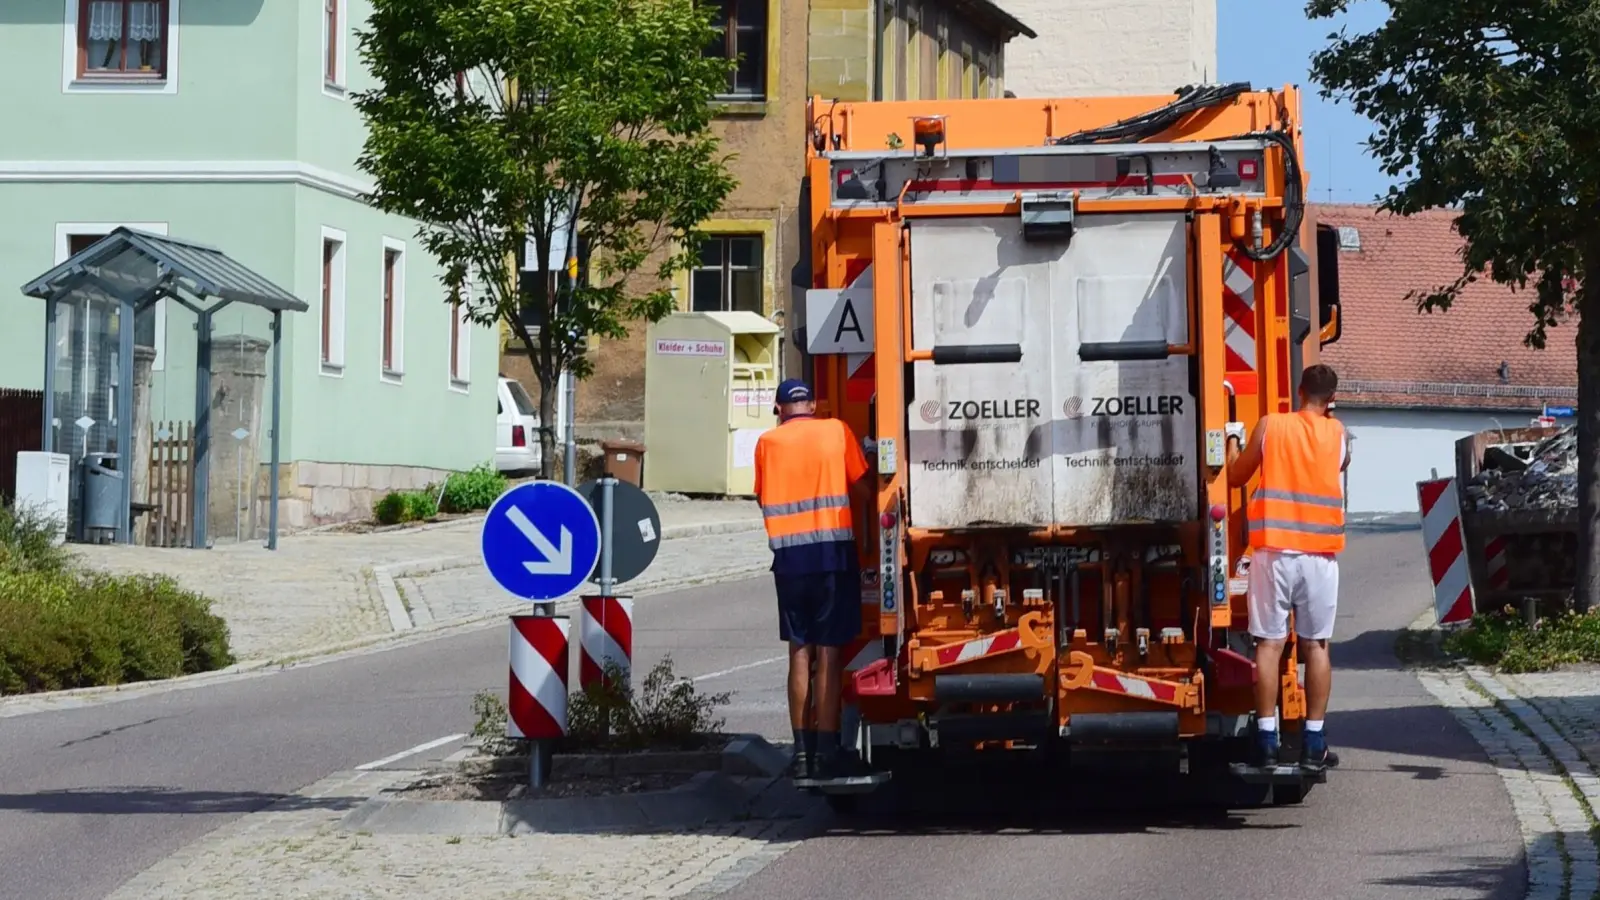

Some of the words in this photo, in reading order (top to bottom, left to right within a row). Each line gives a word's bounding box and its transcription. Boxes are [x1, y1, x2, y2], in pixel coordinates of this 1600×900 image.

[834, 298, 865, 342] A
[658, 342, 685, 352] Kleider
[695, 343, 723, 353] Schuhe
[948, 399, 1040, 420] ZOELLER
[1091, 396, 1183, 416] ZOELLER
[921, 458, 967, 471] Technik
[970, 456, 1041, 470] entscheidet
[1064, 455, 1110, 467] Technik
[1113, 453, 1184, 466] entscheidet
